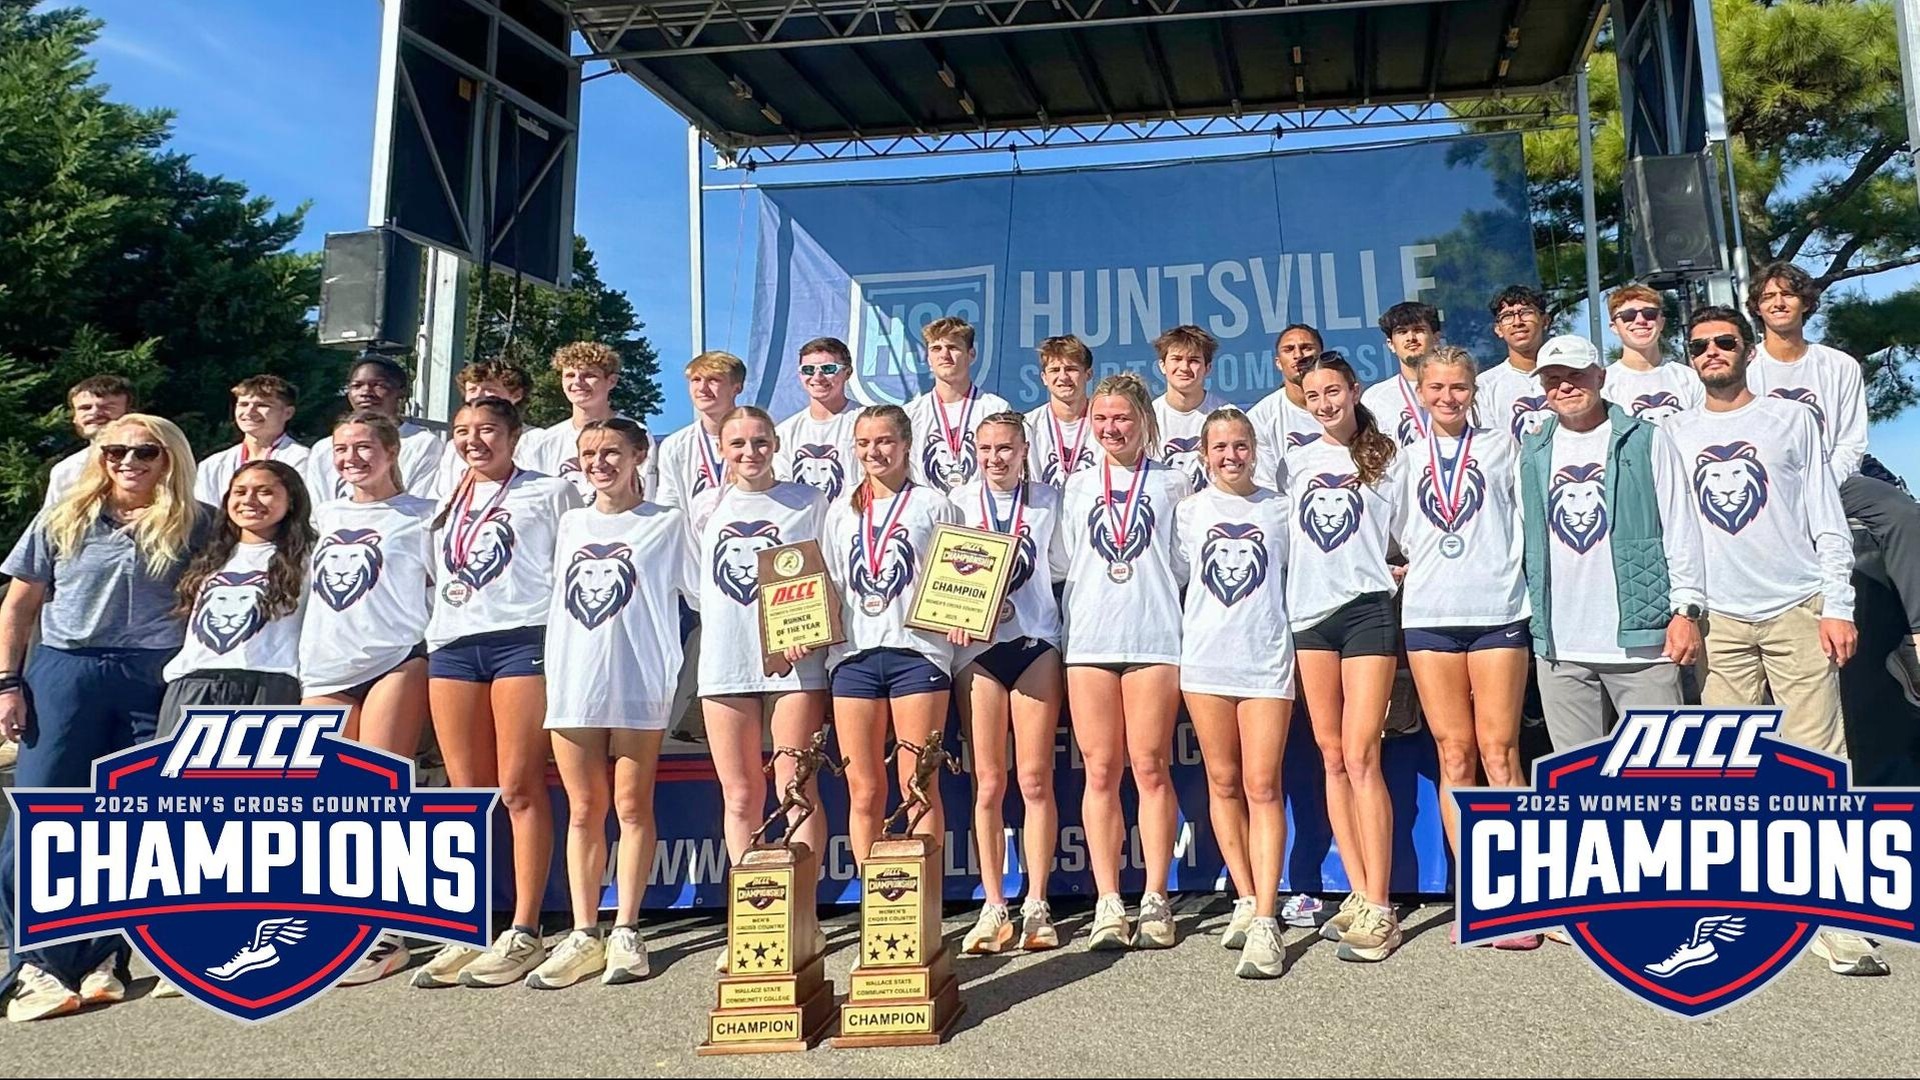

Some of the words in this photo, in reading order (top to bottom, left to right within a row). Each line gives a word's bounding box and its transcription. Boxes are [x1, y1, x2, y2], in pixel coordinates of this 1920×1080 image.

[1018, 243, 1444, 348] HUNTSVILLE
[771, 580, 818, 606] ACCC
[932, 580, 987, 599] CHAMPION
[783, 613, 811, 625] RUNNER
[776, 629, 785, 637] OF
[787, 625, 800, 634] THE
[801, 621, 821, 631] YEAR
[725, 996, 762, 1004] COMMUNITY
[848, 1012, 926, 1027] CHAMPION
[716, 1020, 794, 1035] CHAMPION
